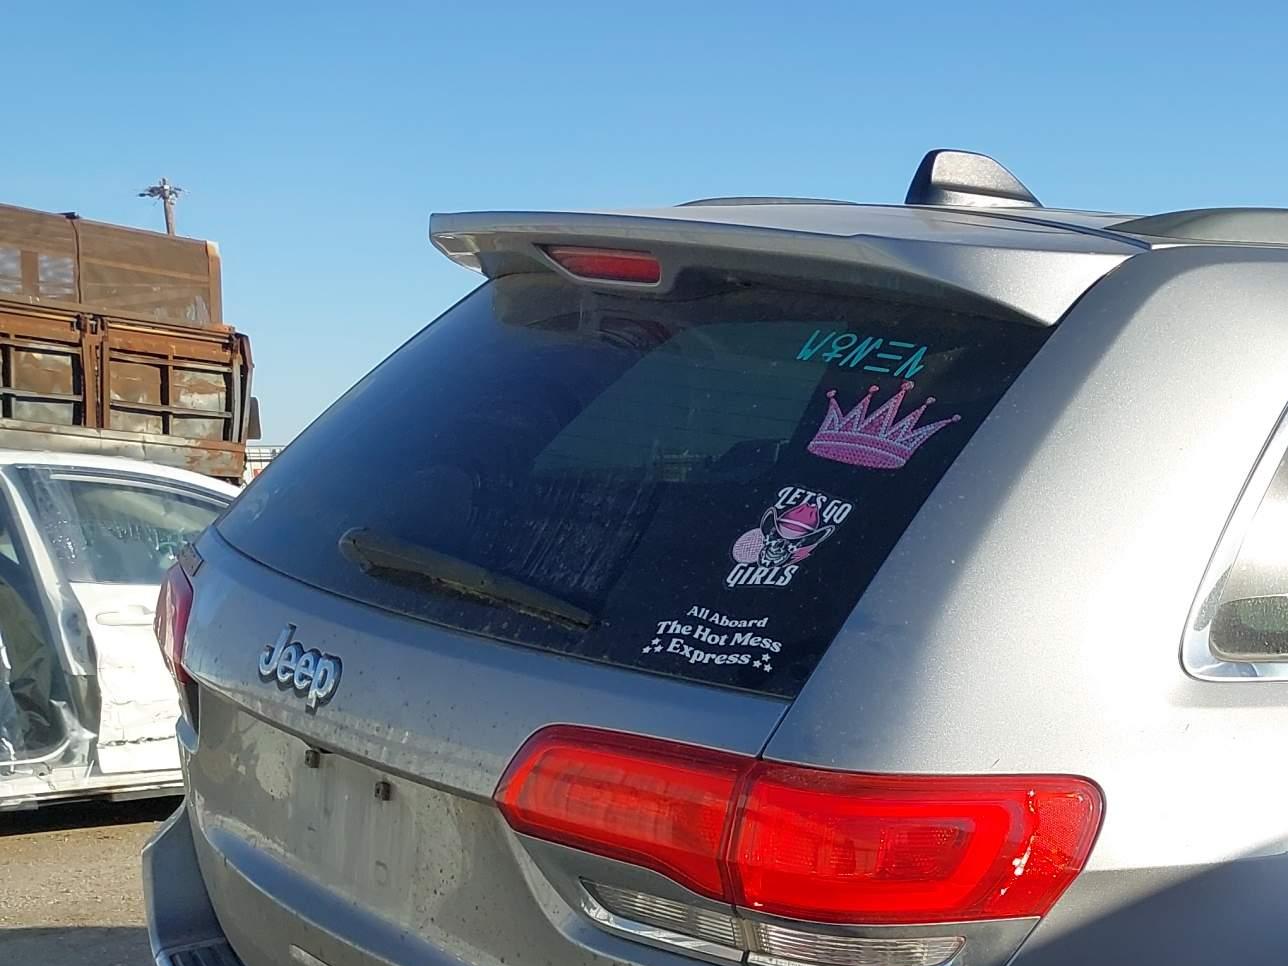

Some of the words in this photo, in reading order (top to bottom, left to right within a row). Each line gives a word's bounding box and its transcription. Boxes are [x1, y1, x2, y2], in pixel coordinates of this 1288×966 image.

[822, 499, 853, 524] GO
[726, 563, 800, 588] GIRLS
[686, 605, 710, 620] All
[709, 612, 769, 628] Aboard
[656, 620, 693, 635] The
[692, 624, 729, 646] Hot
[729, 632, 782, 653] Mess
[666, 637, 752, 665] Express
[258, 623, 342, 714] Jeep
